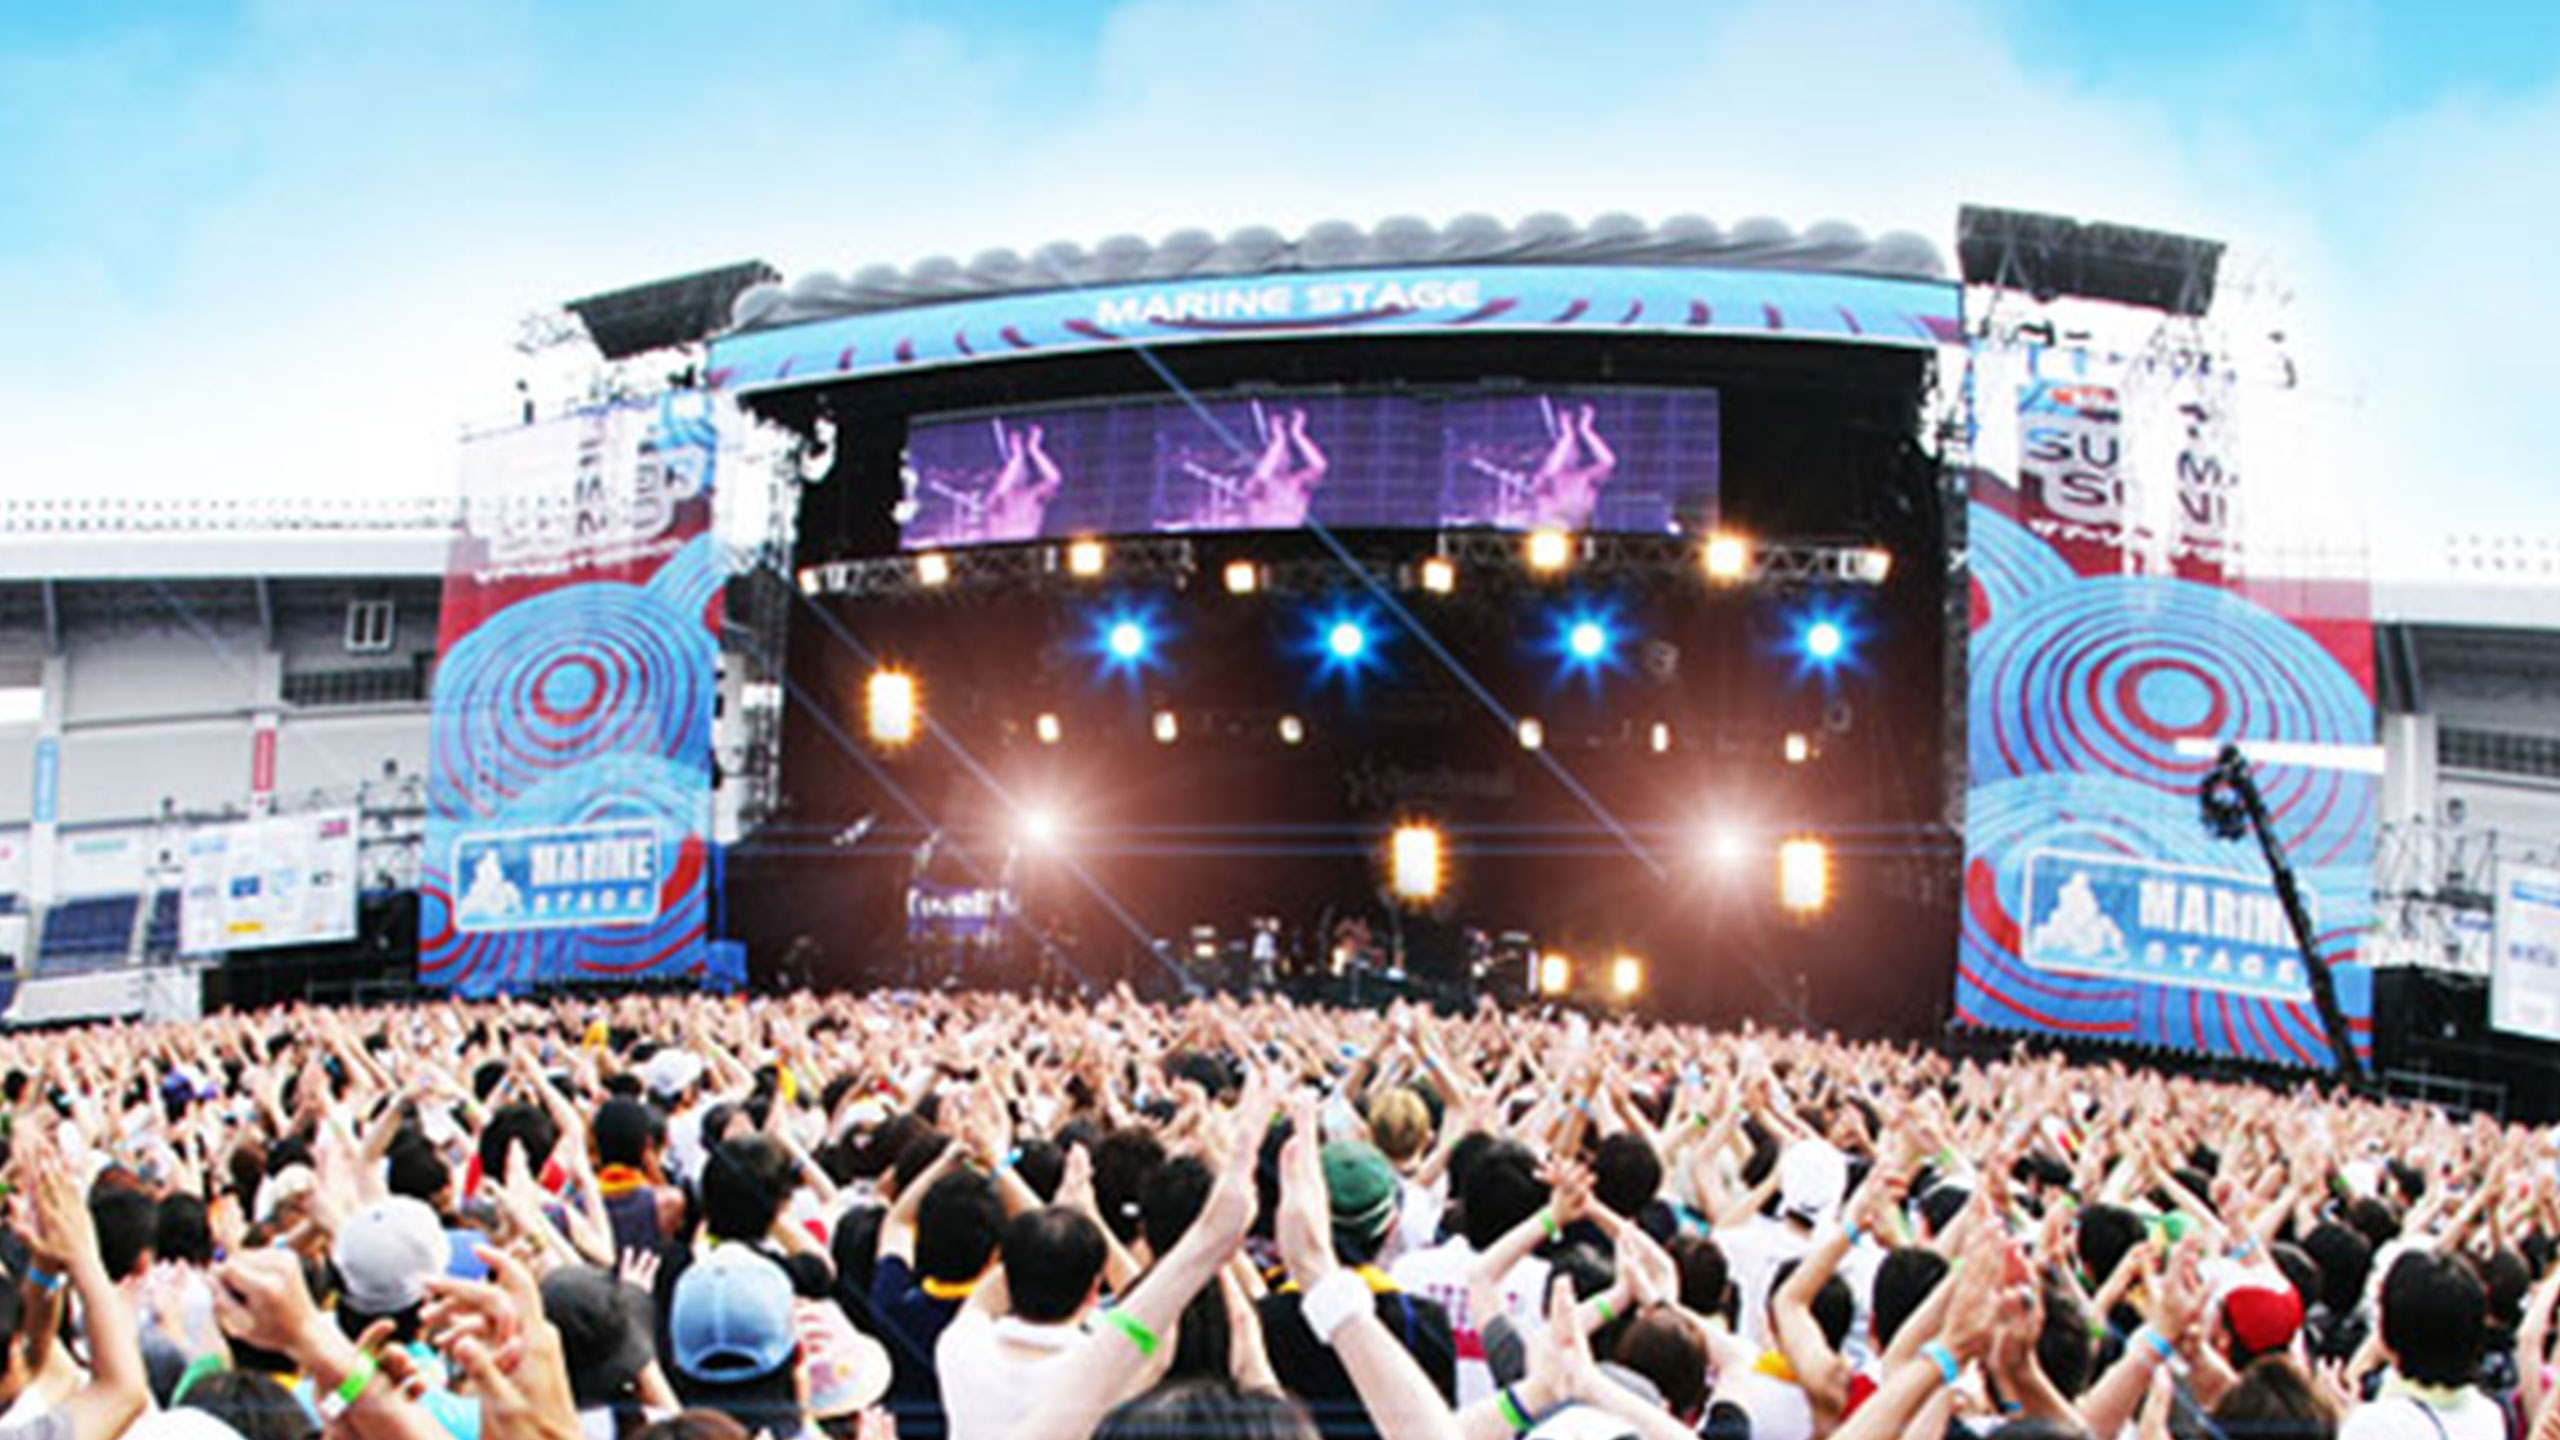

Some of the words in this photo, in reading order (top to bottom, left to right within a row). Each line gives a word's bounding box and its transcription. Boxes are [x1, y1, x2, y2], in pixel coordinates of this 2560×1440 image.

[1096, 286, 1292, 326] MARINE
[1305, 279, 1480, 313] STAGE
[531, 838, 653, 887] MARINE
[2145, 940, 2299, 983] STAGE
